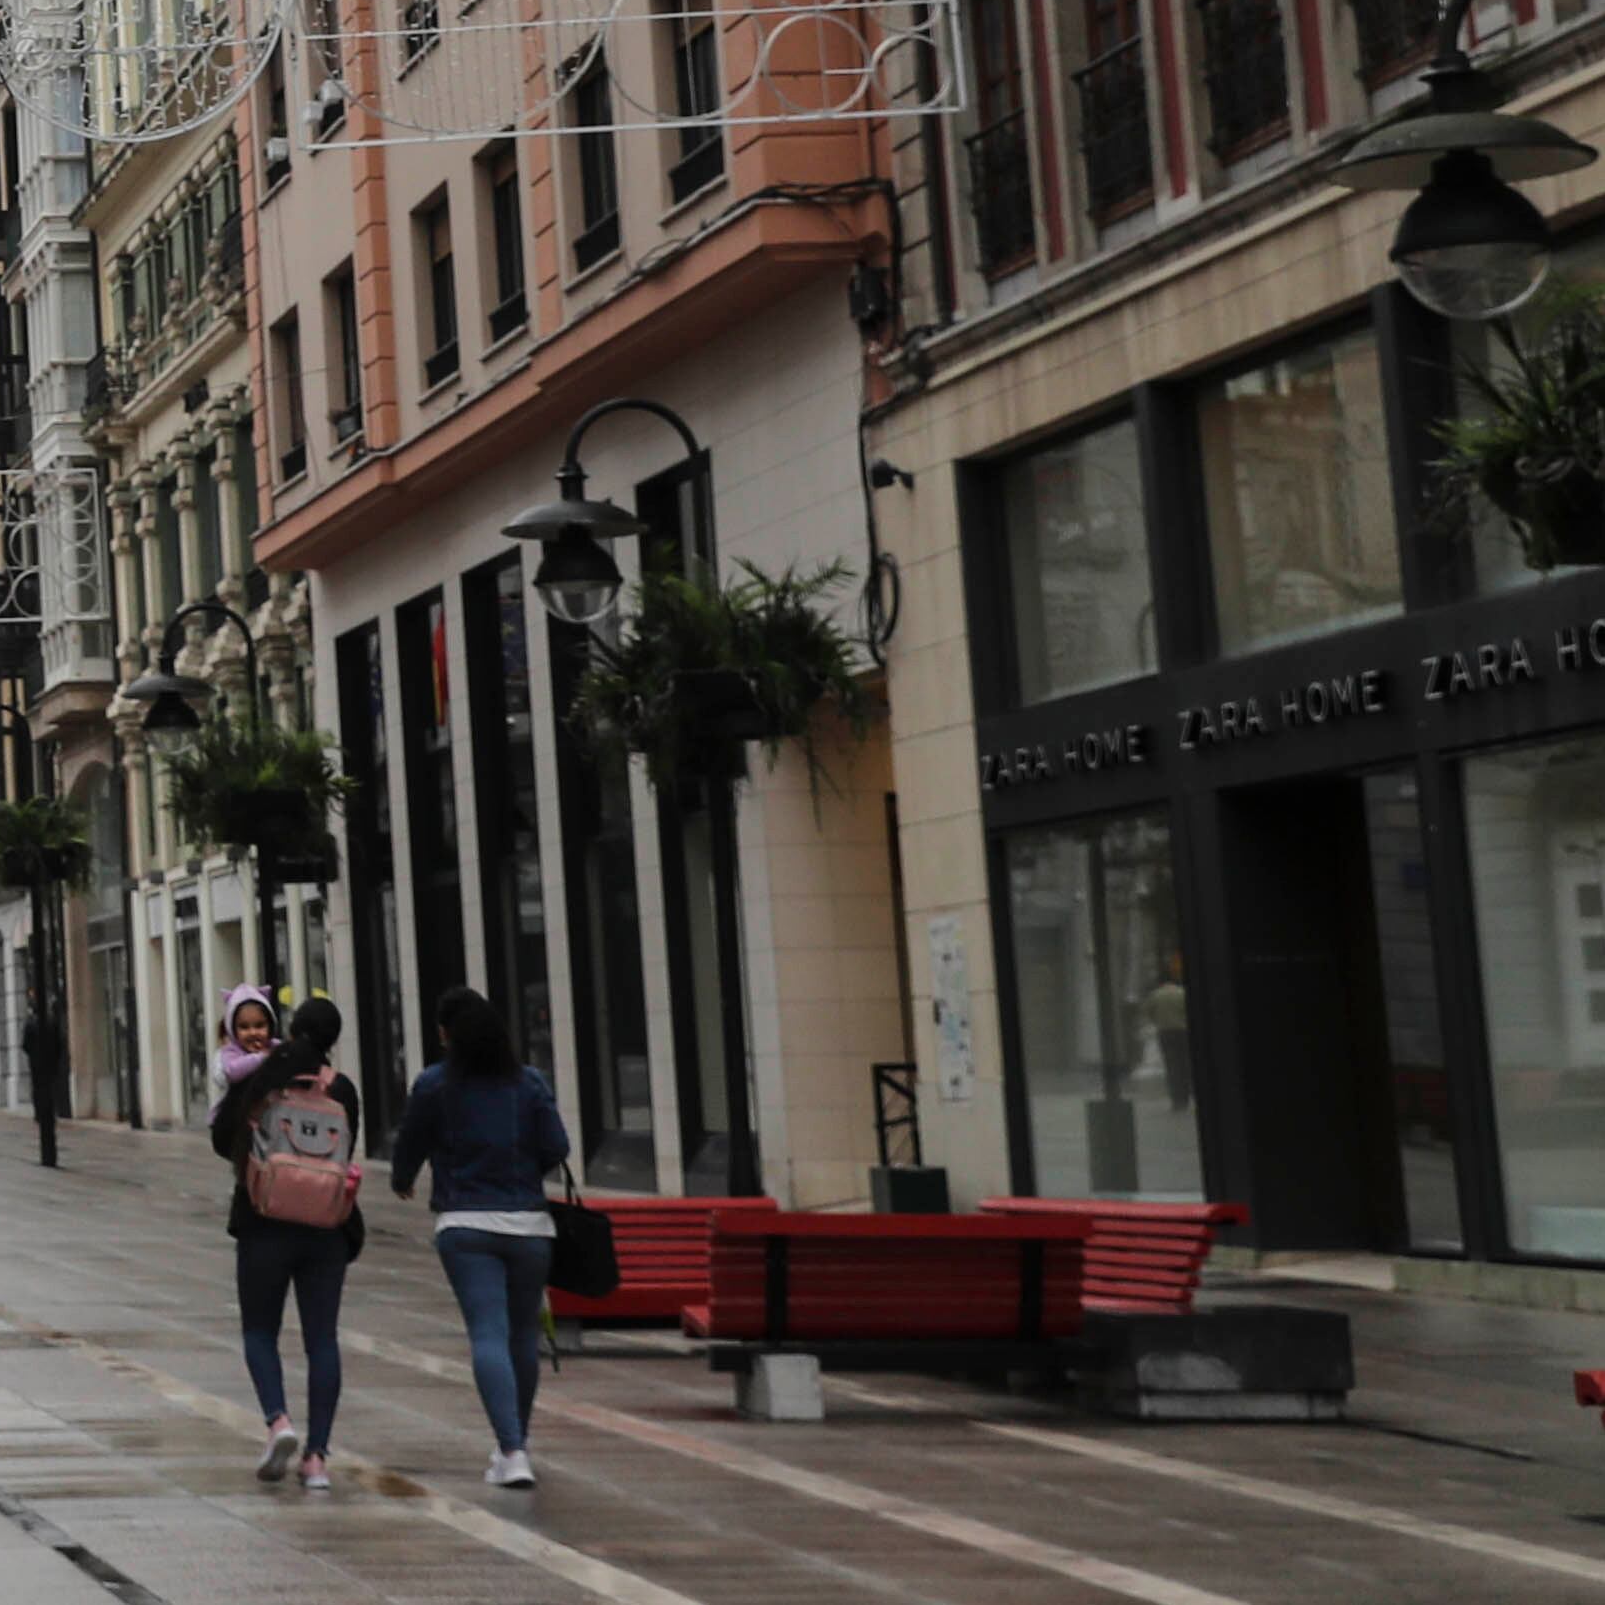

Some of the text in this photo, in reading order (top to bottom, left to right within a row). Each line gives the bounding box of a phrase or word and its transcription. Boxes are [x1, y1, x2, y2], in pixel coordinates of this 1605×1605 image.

[981, 746, 1054, 791] ZARA
[1063, 724, 1144, 770] HOME
[1176, 696, 1267, 750] ZARA
[1281, 670, 1384, 725] HOME
[1420, 637, 1534, 701] ZARA
